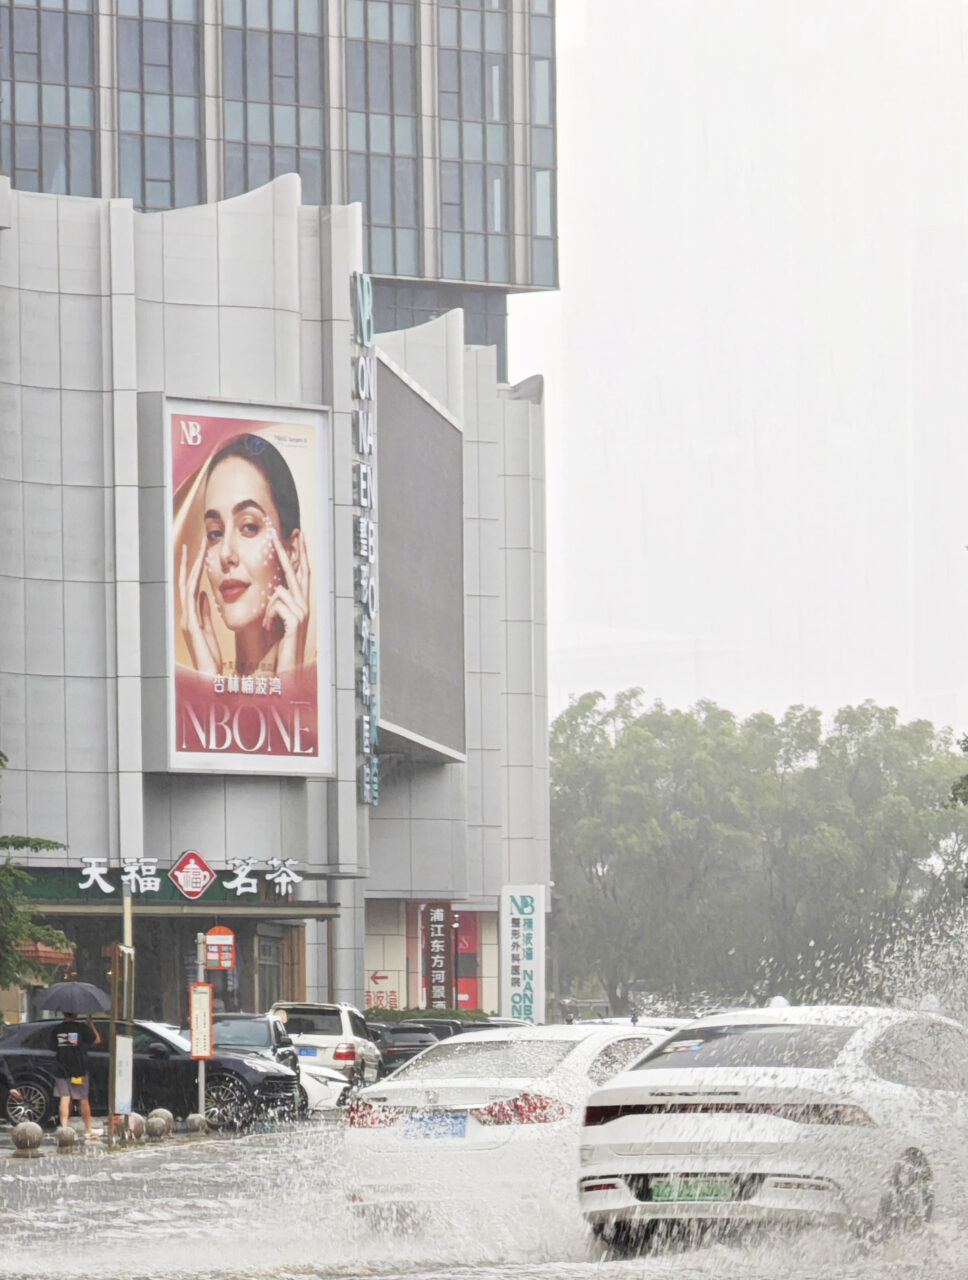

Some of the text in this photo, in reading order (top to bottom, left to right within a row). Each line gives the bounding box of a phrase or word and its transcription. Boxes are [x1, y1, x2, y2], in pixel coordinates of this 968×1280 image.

[180, 420, 202, 446] NB
[181, 703, 315, 753] NBONE
[509, 895, 535, 915] NB
